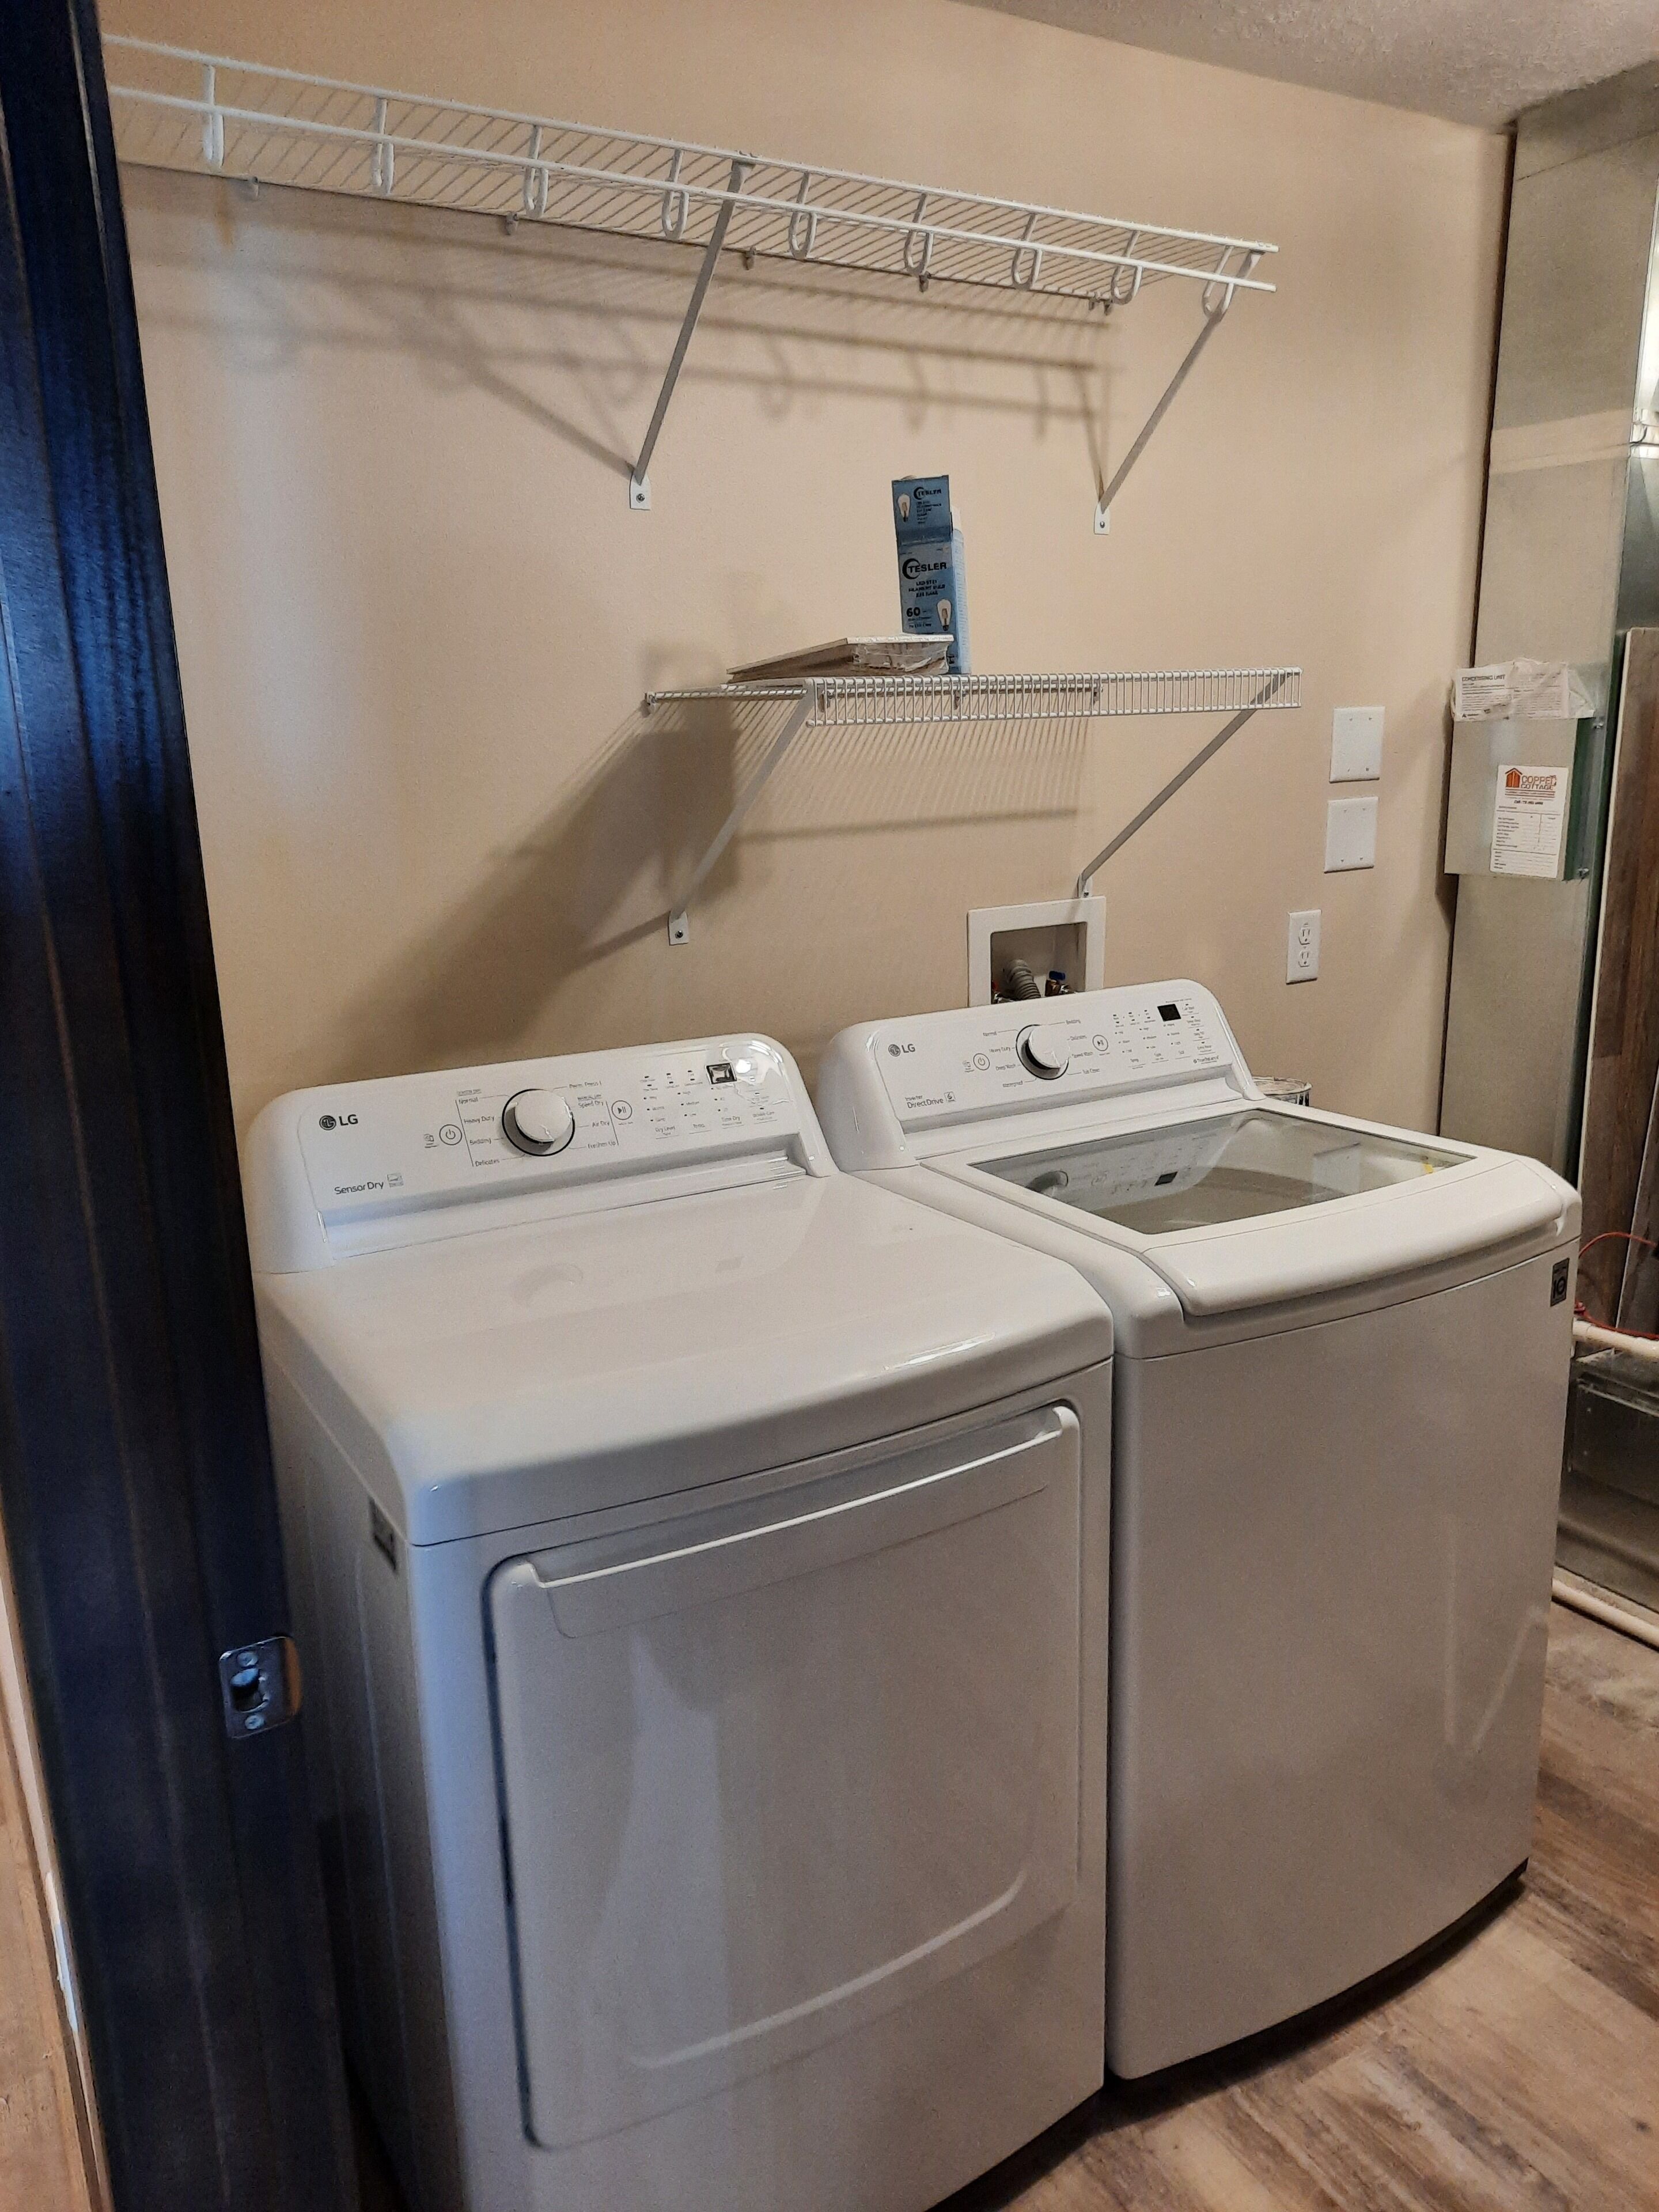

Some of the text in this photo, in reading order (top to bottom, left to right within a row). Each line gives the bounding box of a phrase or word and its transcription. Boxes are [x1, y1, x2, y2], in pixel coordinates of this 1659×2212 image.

[907, 562, 947, 574] TESLER
[906, 607, 921, 617] 60
[902, 1043, 916, 1054] LG
[338, 1113, 358, 1126] LG
